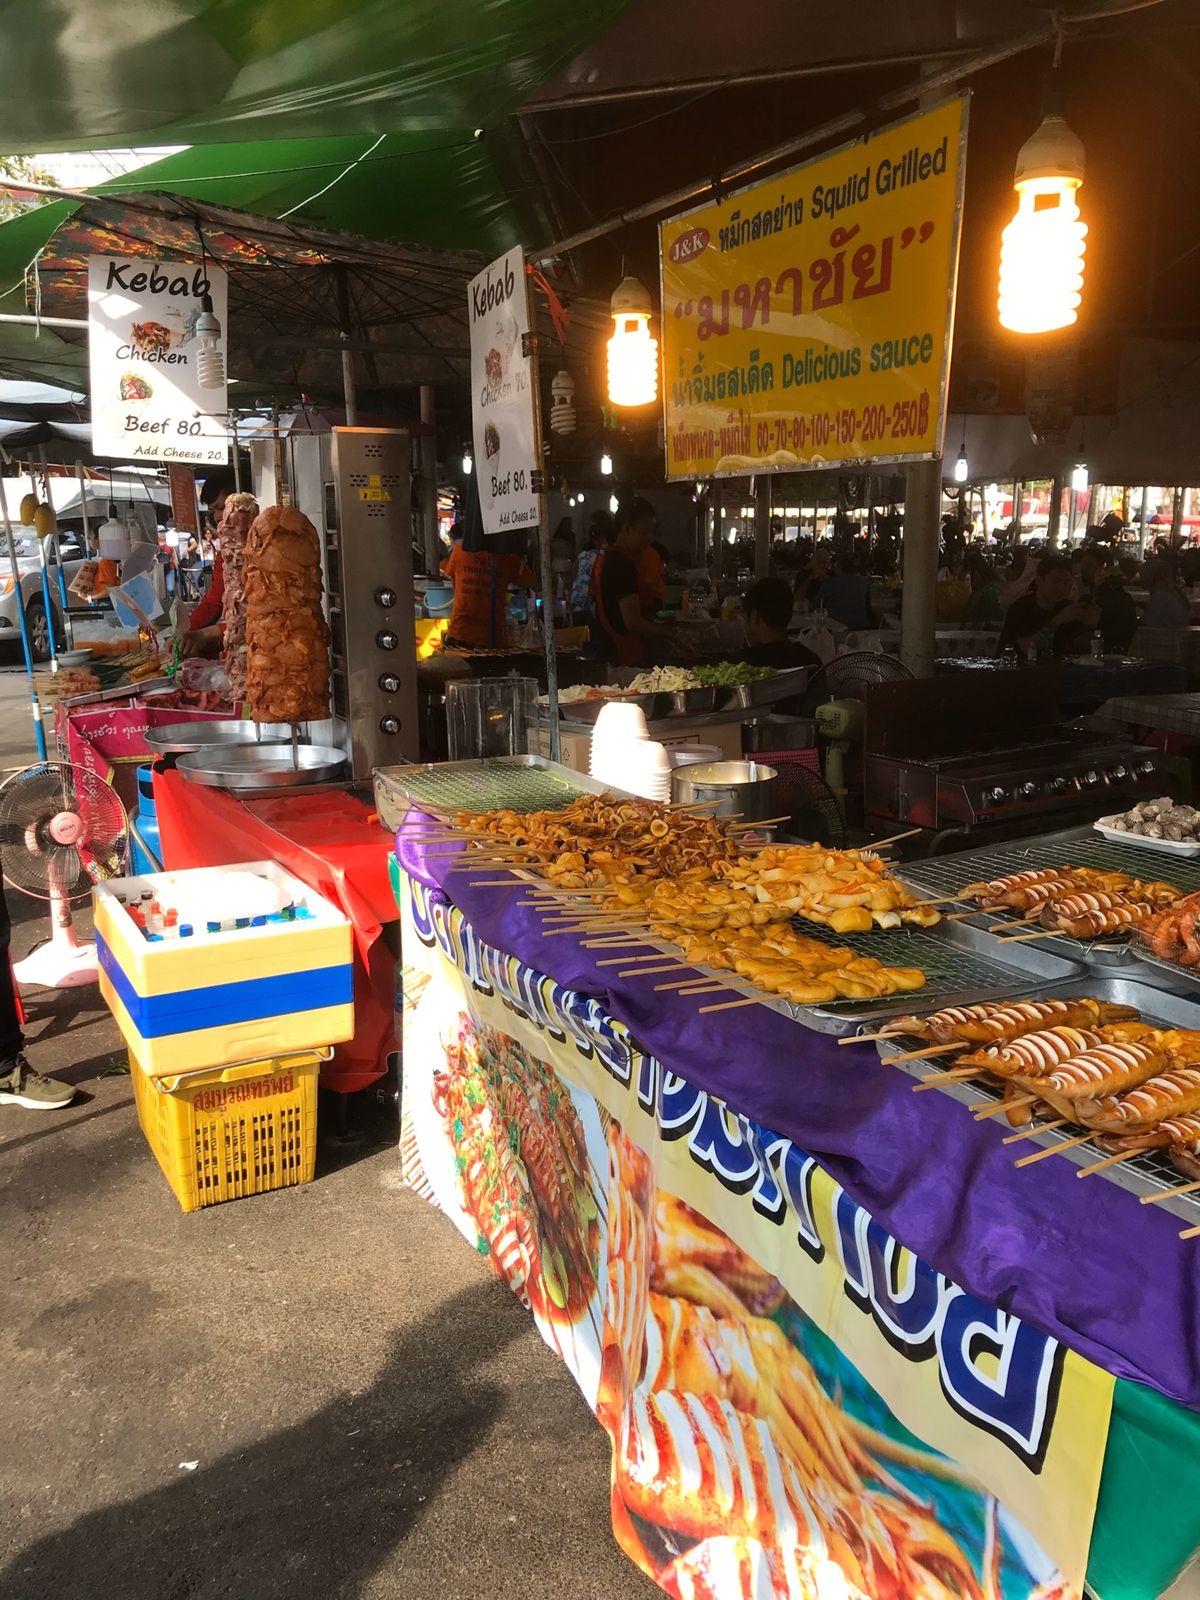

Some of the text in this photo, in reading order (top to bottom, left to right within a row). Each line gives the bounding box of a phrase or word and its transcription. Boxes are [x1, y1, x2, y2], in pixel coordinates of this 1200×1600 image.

[718, 194, 804, 253] หมึกสดย่าง
[876, 136, 948, 195] Grilled
[672, 231, 704, 261] J&K
[106, 261, 211, 298] Kebab
[472, 258, 515, 323] Kebab
[115, 345, 188, 365] Chicken
[781, 345, 862, 390] Delicious
[869, 332, 934, 372] sauce
[124, 414, 206, 436] Beef 80.
[133, 445, 225, 461] Add Cheese 20.
[491, 469, 528, 498] Beef 80.
[499, 511, 511, 527] Add
[511, 509, 529, 523] Cheese
